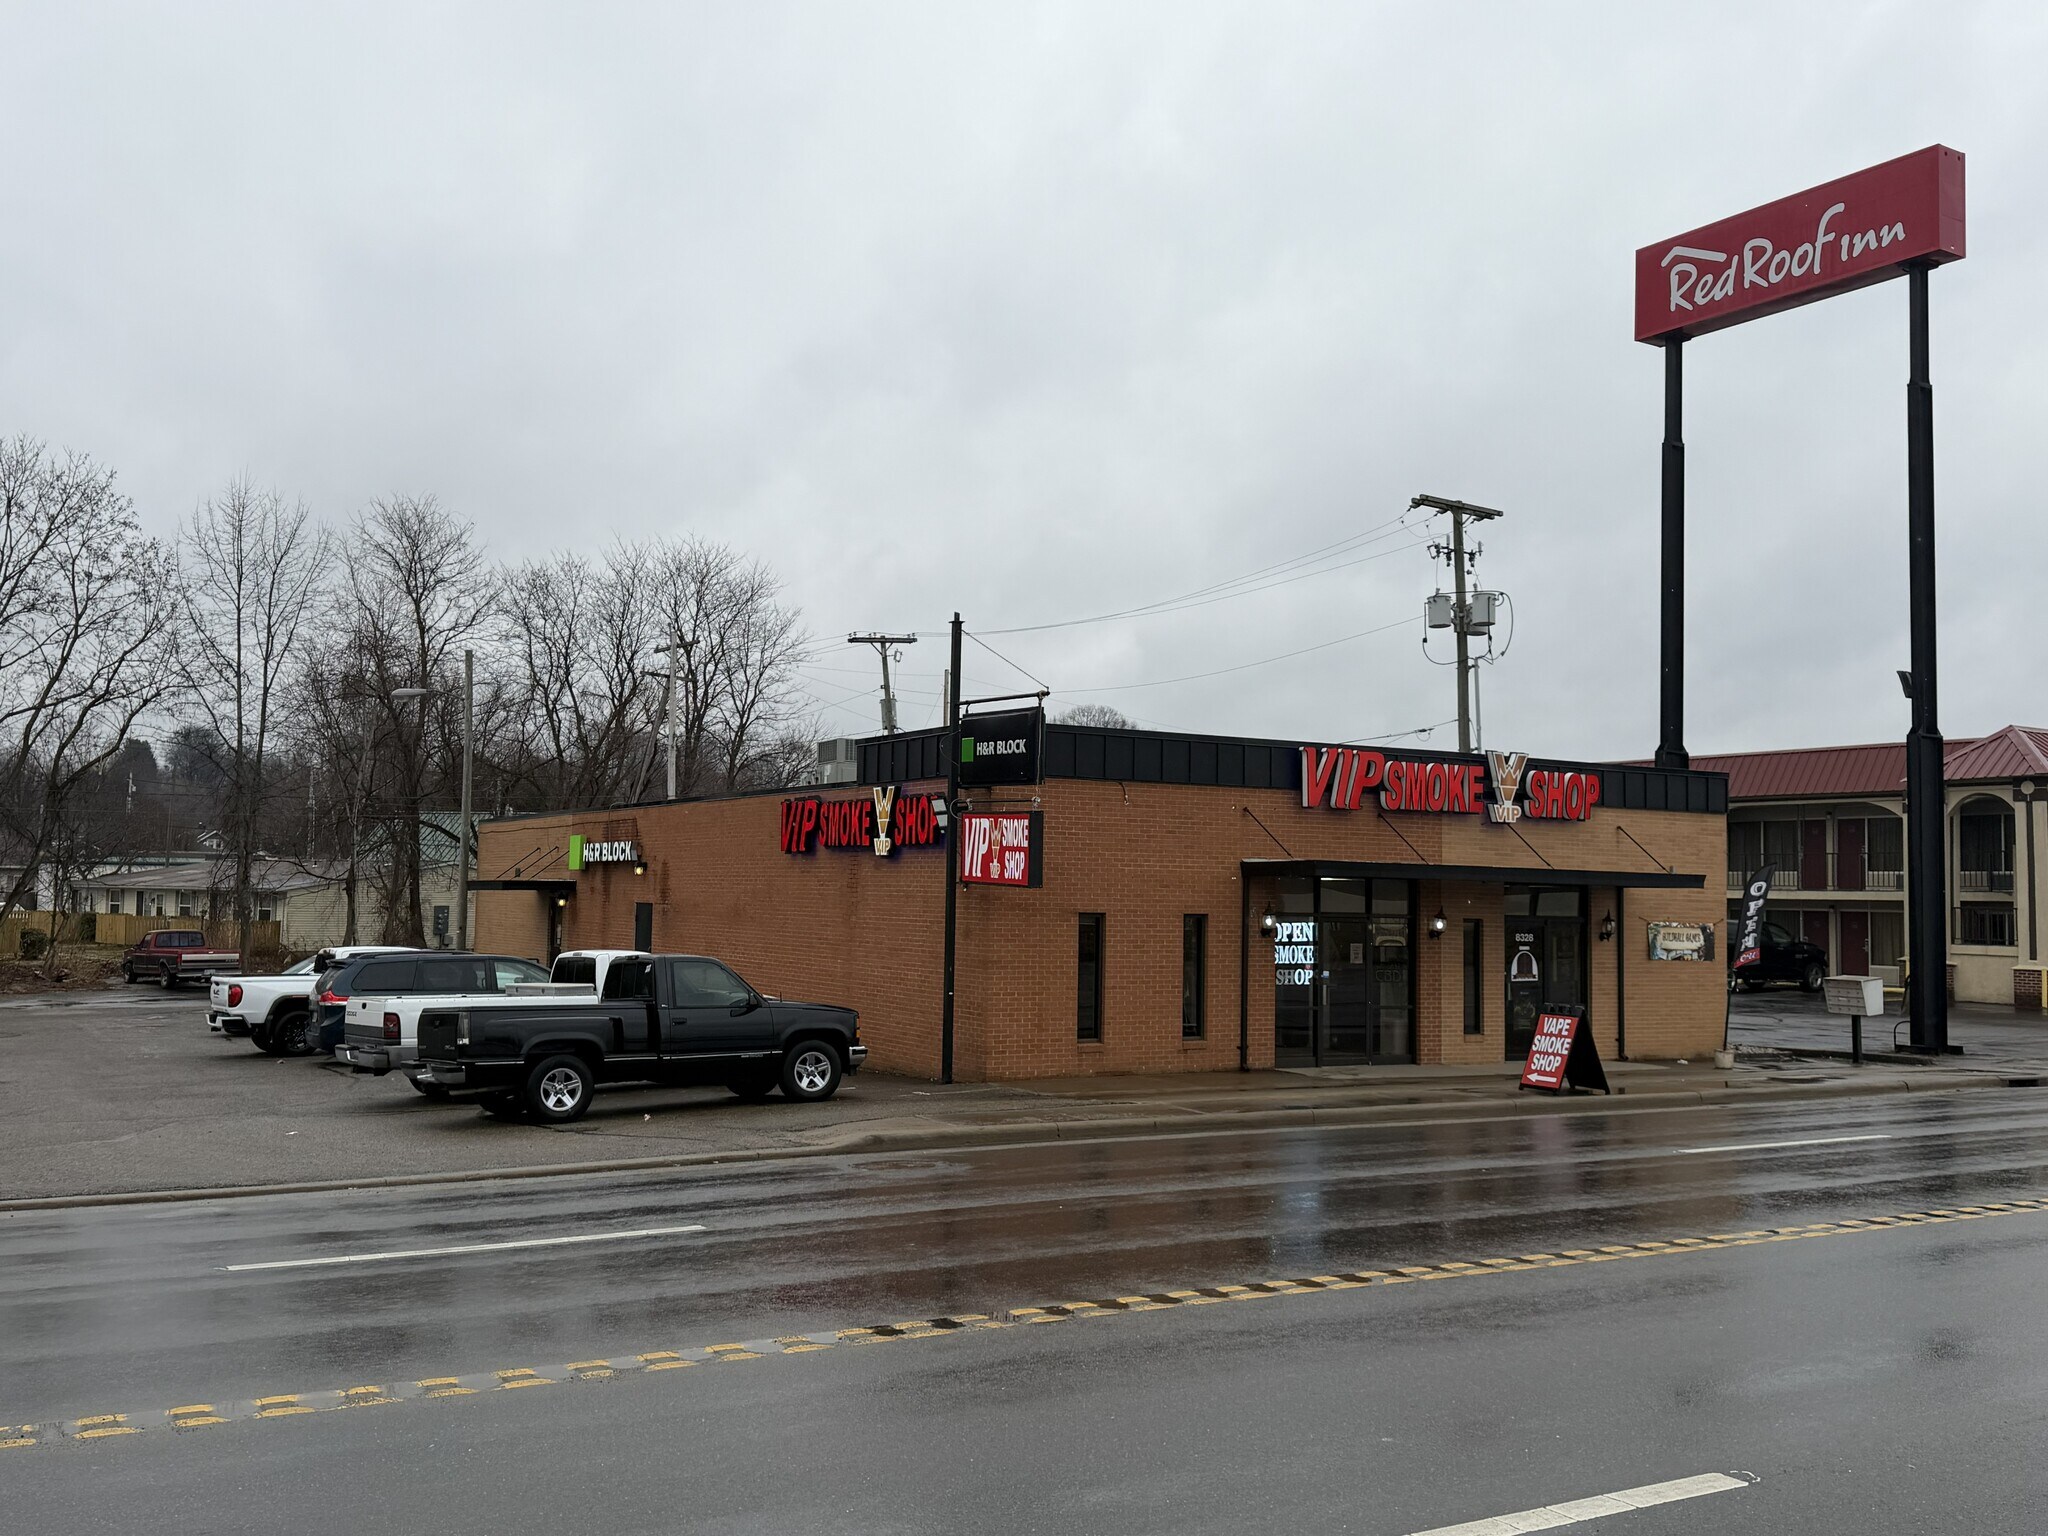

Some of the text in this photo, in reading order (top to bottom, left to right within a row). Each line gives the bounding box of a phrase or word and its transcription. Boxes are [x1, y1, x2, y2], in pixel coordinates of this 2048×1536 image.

[1669, 254, 1739, 312] Red
[1743, 202, 1845, 289] Roof
[976, 738, 1027, 756] H&R BLOCK
[1299, 747, 1600, 821] VIP SMOKE SHOP
[1491, 805, 1522, 823] VIP
[780, 800, 818, 852] VIP
[818, 801, 872, 847] SMOKE
[583, 841, 633, 862] H&R BLOCK
[873, 838, 892, 856] VIP
[964, 818, 1030, 878] VIP SMOKE
[1004, 850, 1026, 880] SHOP
[1740, 881, 1767, 952] OPEN
[1275, 968, 1314, 985] SHOP
[1543, 1016, 1572, 1036] VAPE
[1532, 1035, 1572, 1055] SMOKE
[1531, 1055, 1562, 1073] SHOP
